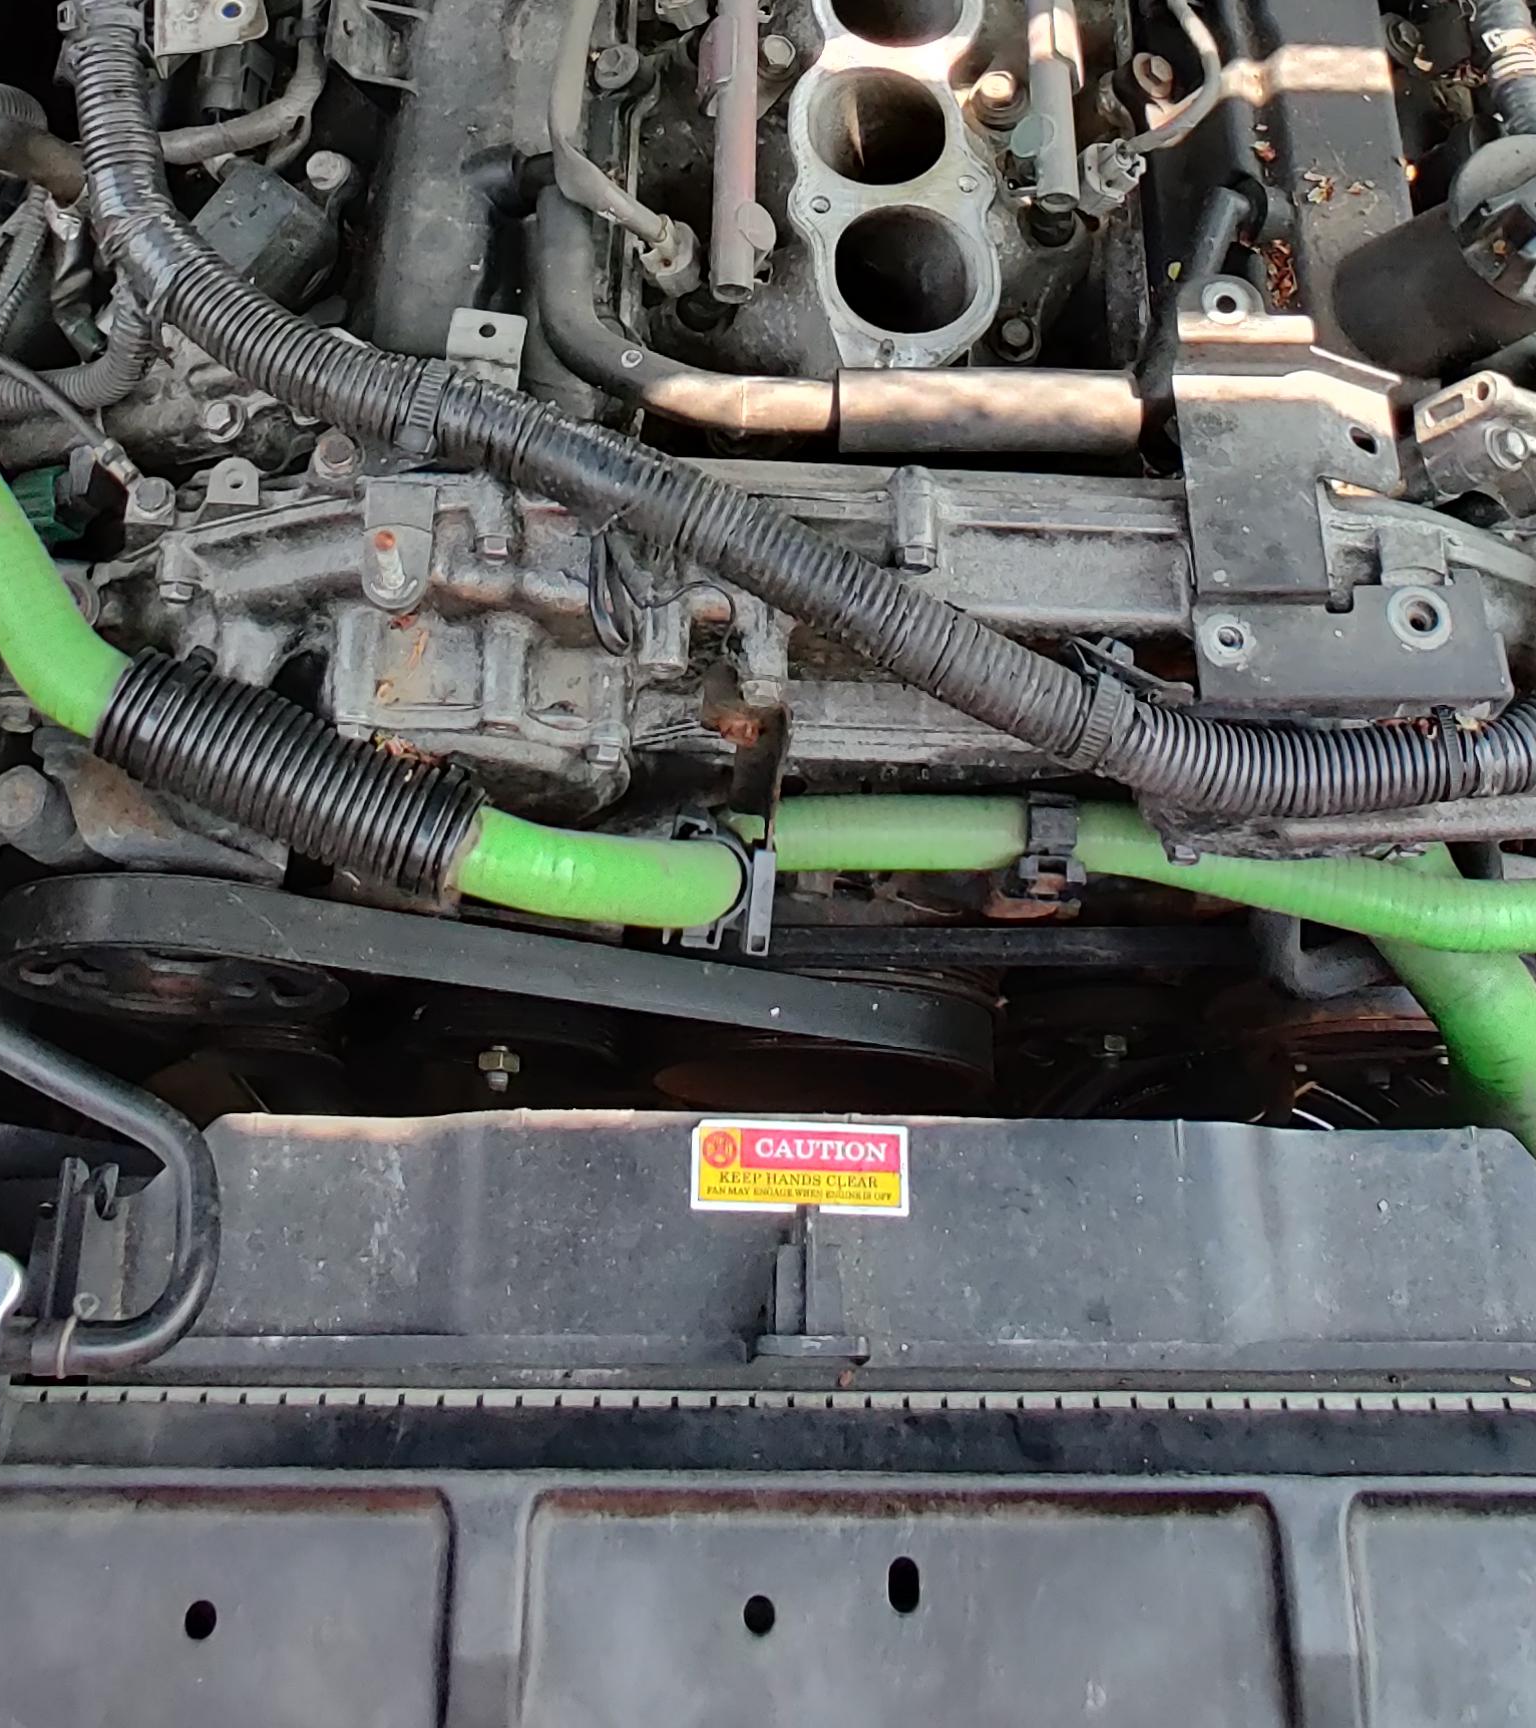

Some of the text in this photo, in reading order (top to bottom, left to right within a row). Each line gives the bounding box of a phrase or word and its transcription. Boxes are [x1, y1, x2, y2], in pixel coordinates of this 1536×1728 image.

[755, 1138, 887, 1162] CAUTION
[720, 1171, 878, 1189] KEEP HANDS CLEAR
[707, 1186, 725, 1195] FAN
[728, 1187, 750, 1196] MAY
[753, 1187, 793, 1198] ENGAGE
[794, 1188, 822, 1199] WHEN
[826, 1190, 862, 1200] ENGINE
[874, 1191, 892, 1201] OFF
